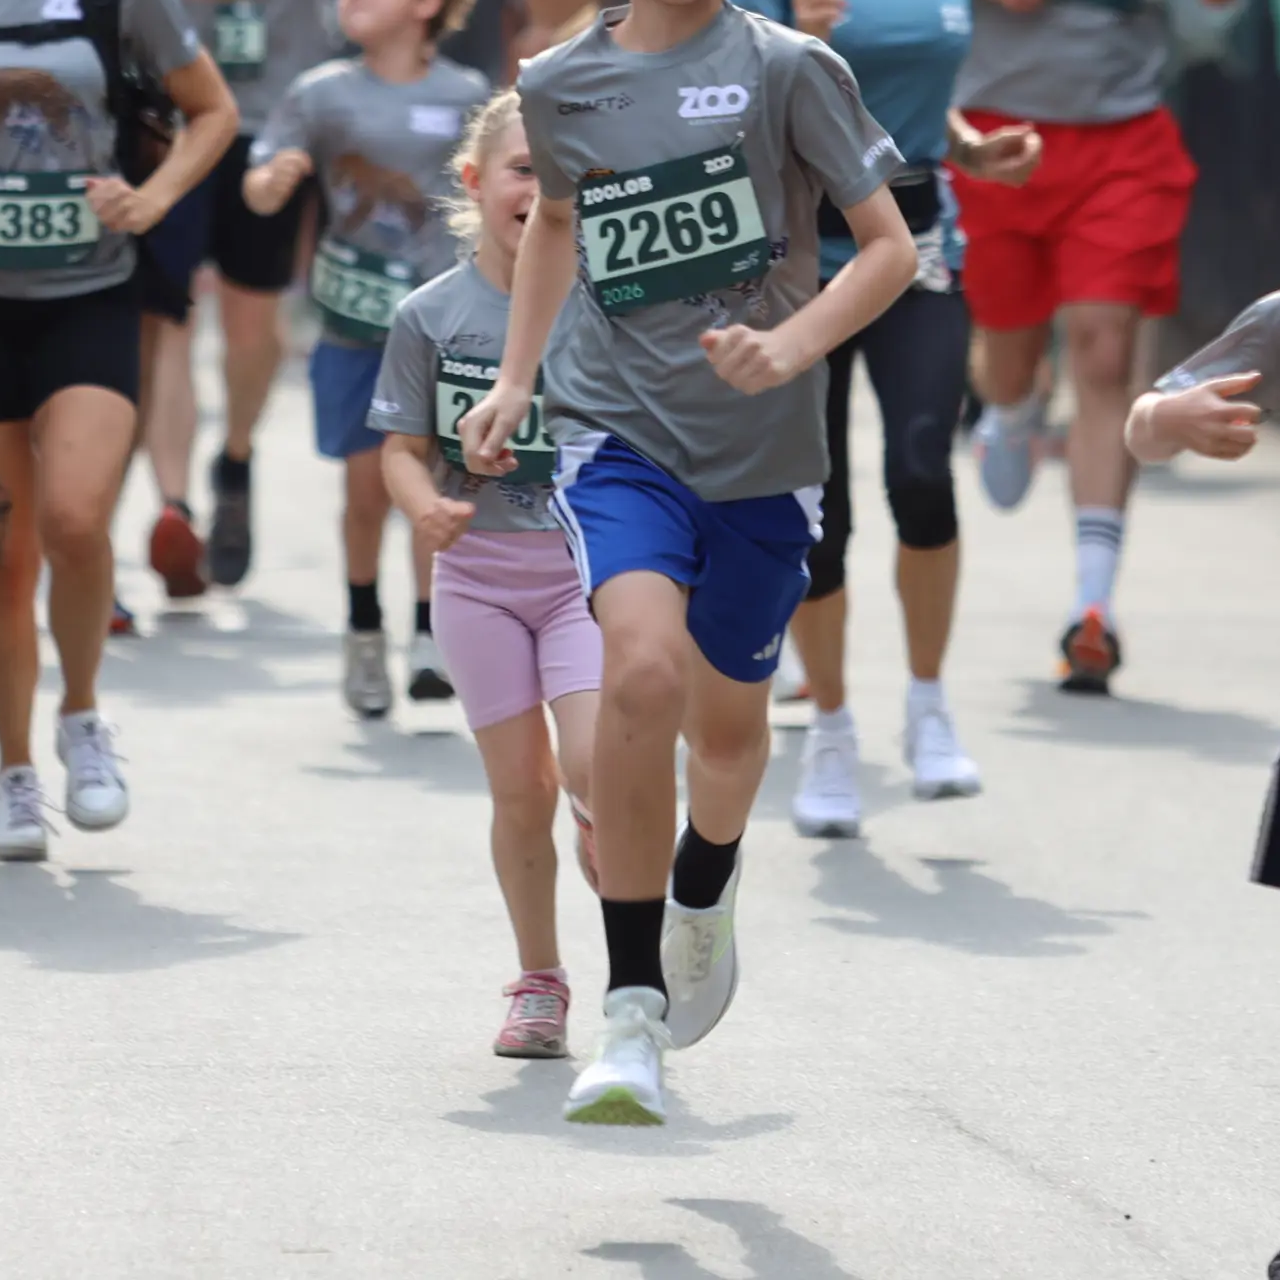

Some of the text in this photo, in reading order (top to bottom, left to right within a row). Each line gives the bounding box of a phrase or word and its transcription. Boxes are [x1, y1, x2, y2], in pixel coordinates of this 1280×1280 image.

[558, 95, 617, 116] CRAFT
[678, 84, 749, 118] ZOO
[703, 155, 735, 174] ZOO
[599, 191, 739, 274] 2269
[602, 282, 645, 306] 2026
